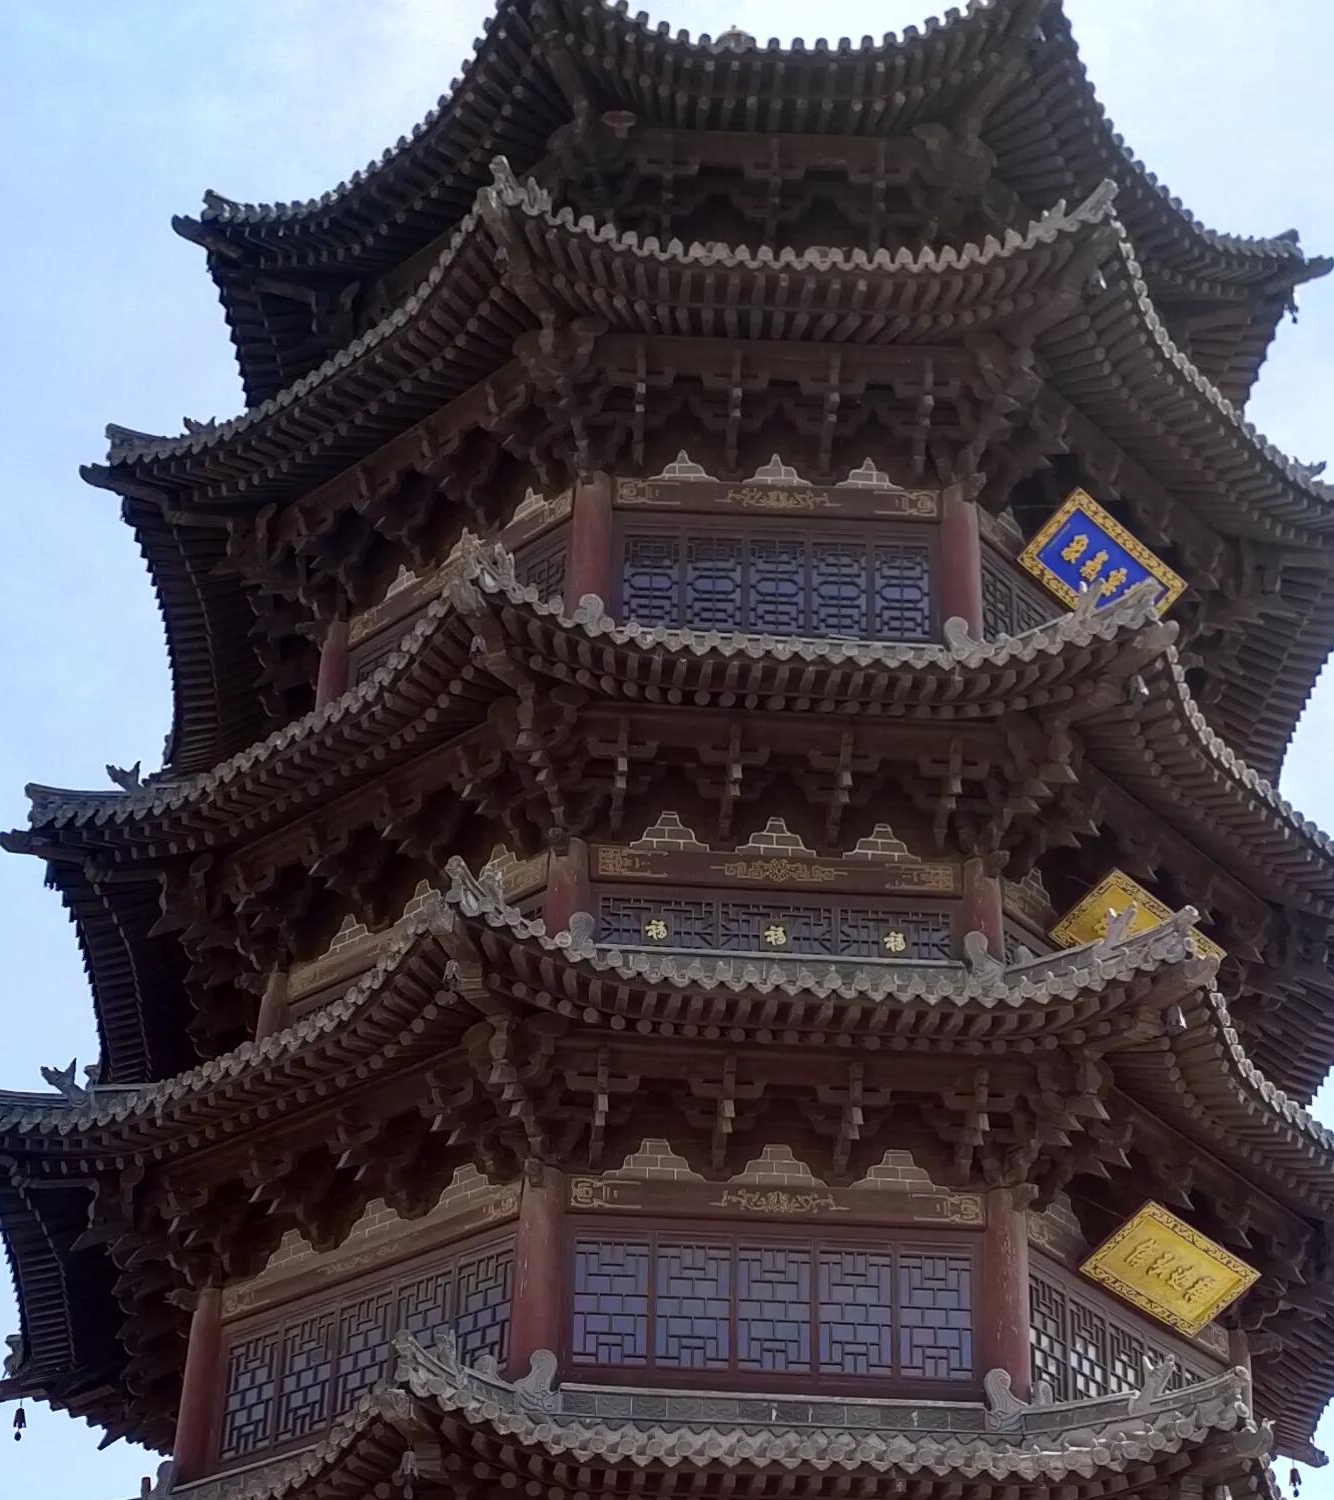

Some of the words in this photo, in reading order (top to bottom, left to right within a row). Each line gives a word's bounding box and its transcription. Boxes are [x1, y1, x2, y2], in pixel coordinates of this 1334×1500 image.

[645, 919, 667, 941] 福
[764, 926, 787, 946] 福
[883, 931, 906, 953] 福
